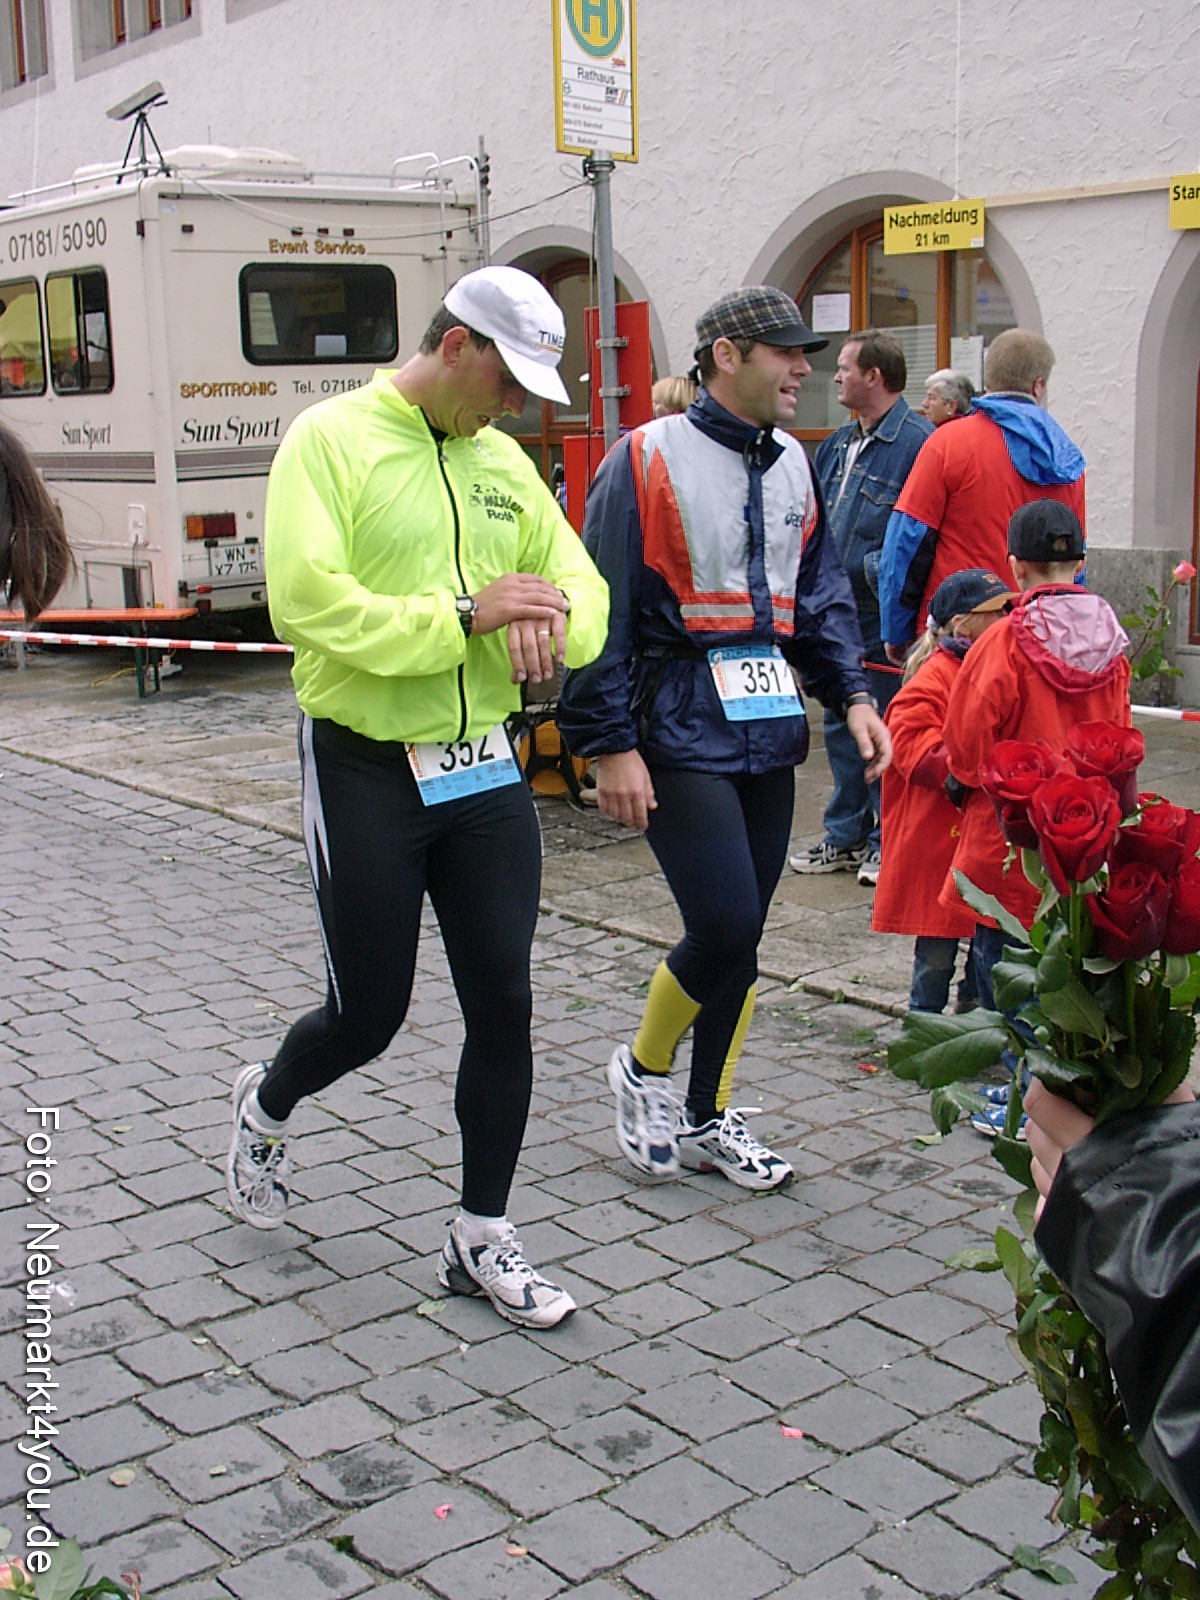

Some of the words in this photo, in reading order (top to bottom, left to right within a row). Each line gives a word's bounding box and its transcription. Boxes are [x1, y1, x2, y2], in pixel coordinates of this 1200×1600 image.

[577, 66, 615, 84] Rathaus
[889, 207, 979, 229] Nachmeldung
[8, 216, 108, 263] 07181/5090
[268, 238, 309, 254] Event
[314, 239, 366, 255] Service
[915, 232, 929, 248] 21
[932, 231, 950, 246] km
[180, 380, 278, 398] SPORTRONIC
[293, 380, 315, 394] Tel.
[225, 547, 245, 561] WN
[741, 661, 782, 694] 351
[437, 735, 495, 772] 352
